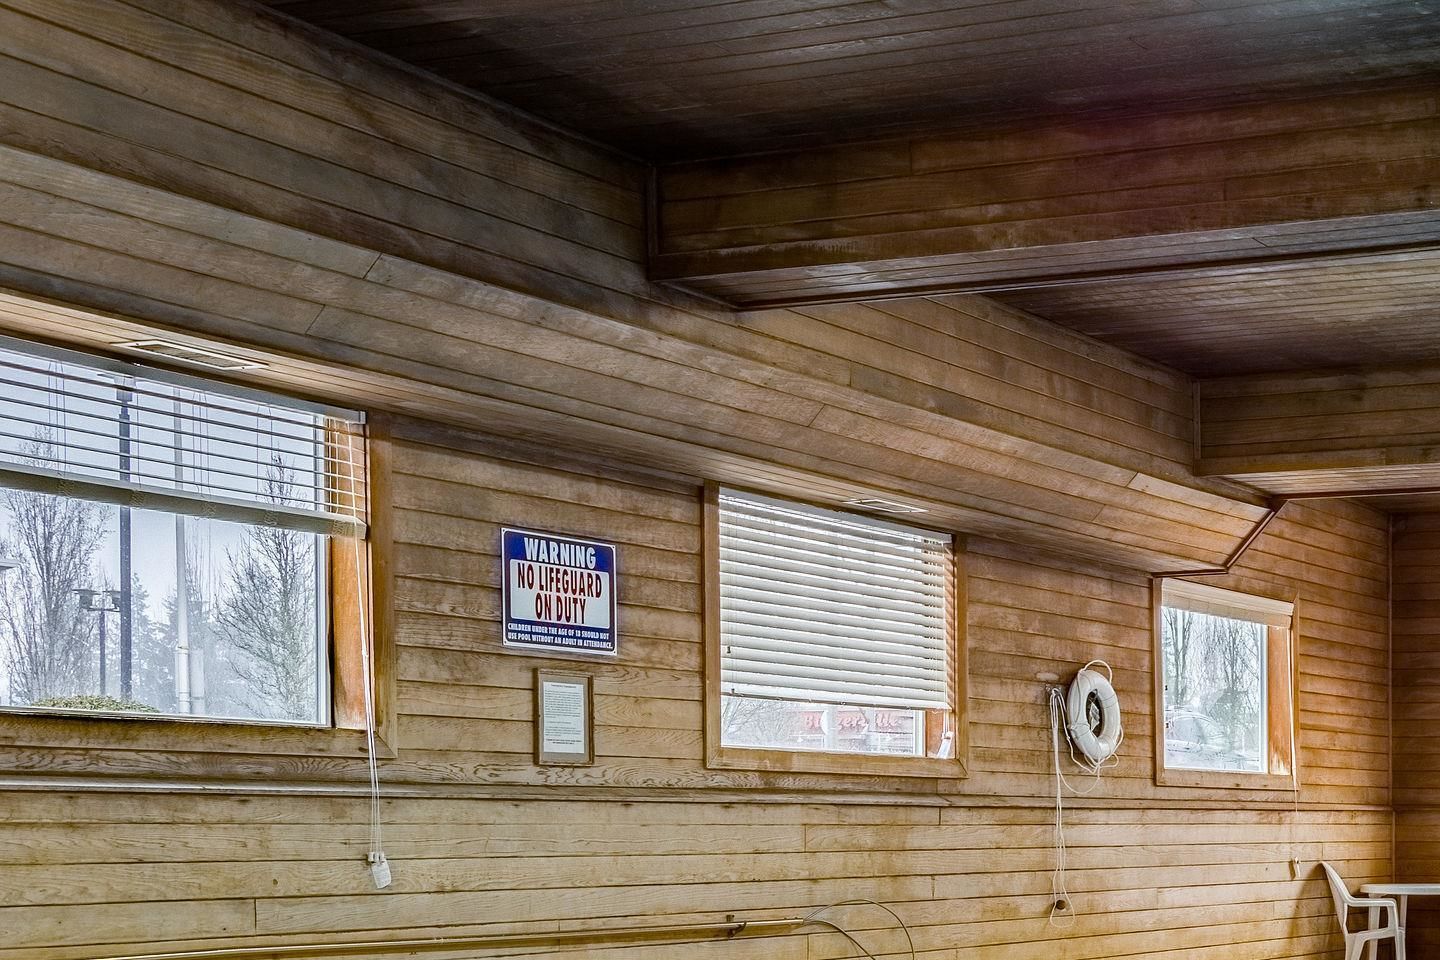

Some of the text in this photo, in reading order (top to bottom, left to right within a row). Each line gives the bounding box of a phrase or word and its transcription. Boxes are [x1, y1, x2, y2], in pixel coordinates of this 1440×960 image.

[524, 537, 596, 569] WARNING
[517, 562, 602, 599] NO LIFEGUARD
[535, 592, 586, 624] ON DUTY
[508, 622, 531, 632] CHILDREN
[532, 625, 548, 634] UNDER
[549, 627, 557, 635] THE
[558, 628, 567, 636] AGE
[582, 630, 599, 639] SHOULD
[600, 632, 609, 640] NOT
[508, 632, 517, 640] USE
[518, 633, 531, 641] POOL
[532, 634, 554, 643] WITHOUT
[554, 636, 561, 644] AN
[562, 637, 577, 646] ADULT
